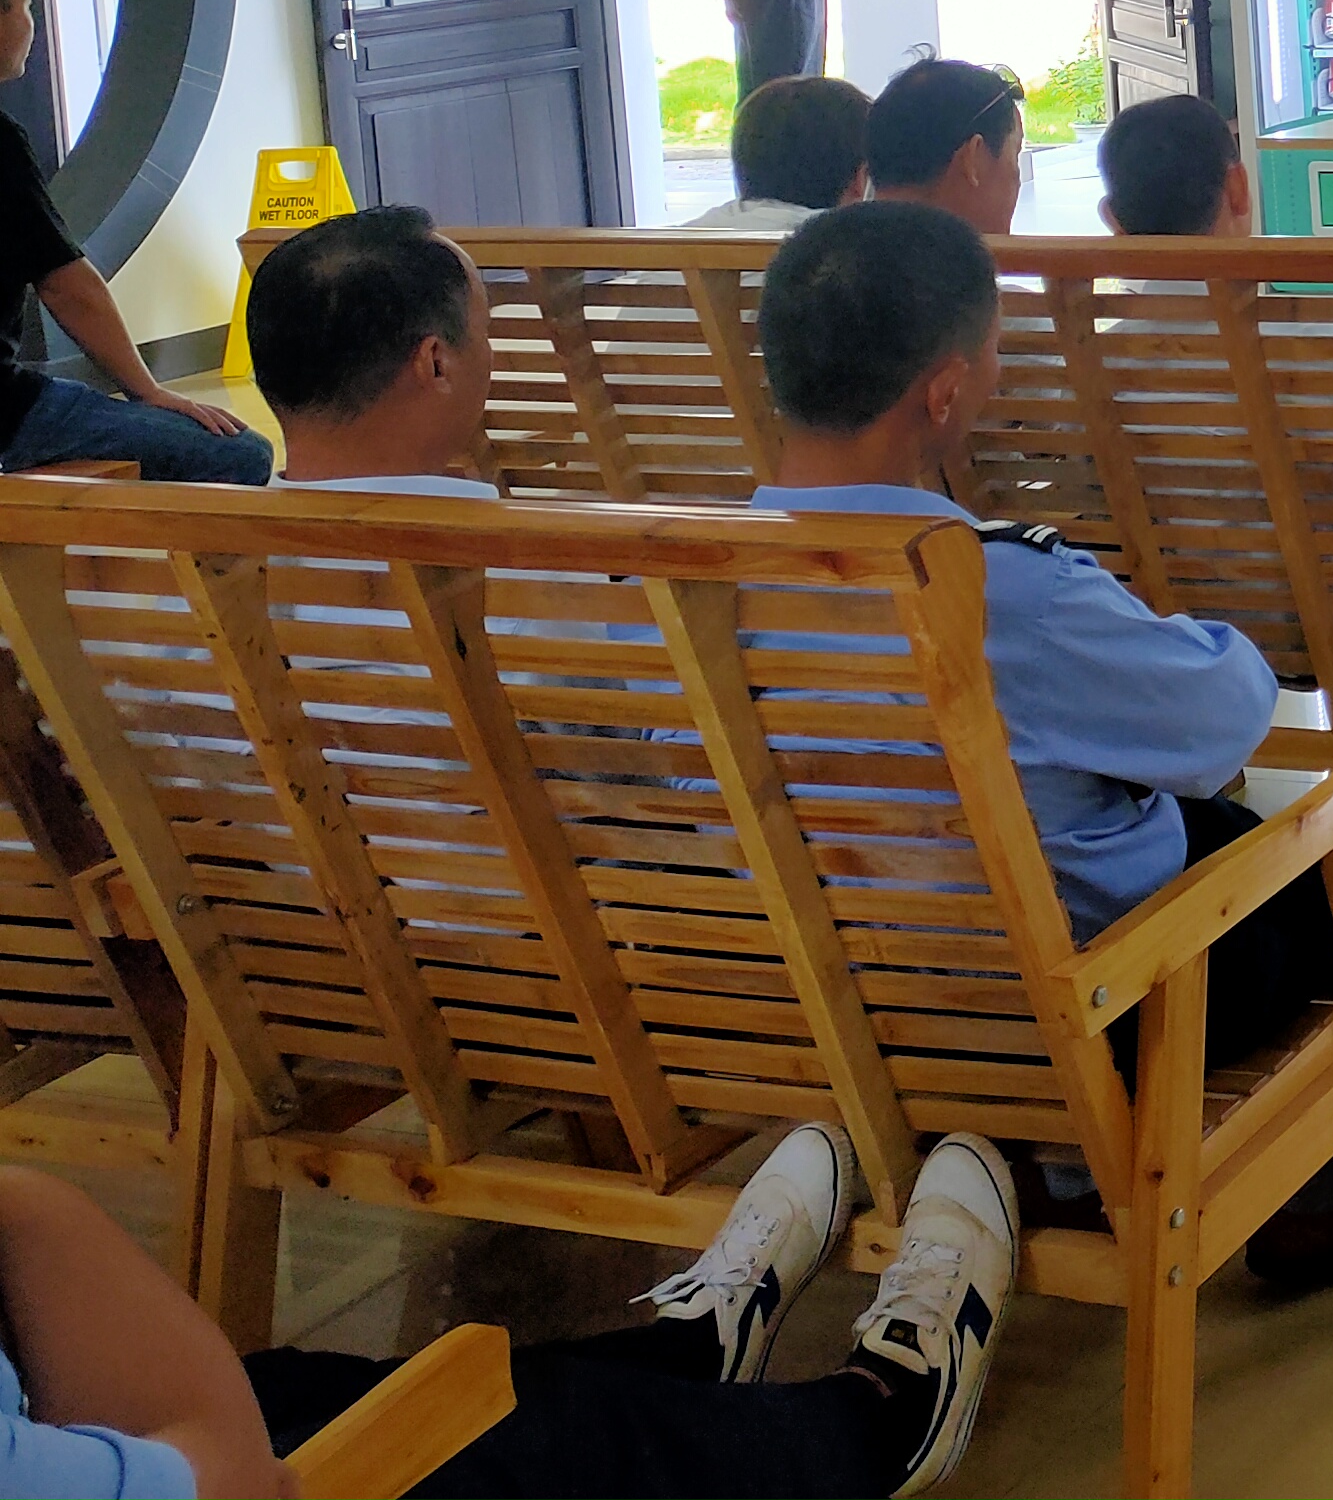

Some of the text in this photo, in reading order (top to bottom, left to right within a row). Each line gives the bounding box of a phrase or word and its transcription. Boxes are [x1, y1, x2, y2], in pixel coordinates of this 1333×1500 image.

[267, 196, 315, 208] CAUTION
[259, 209, 319, 221] WET FLOOR
